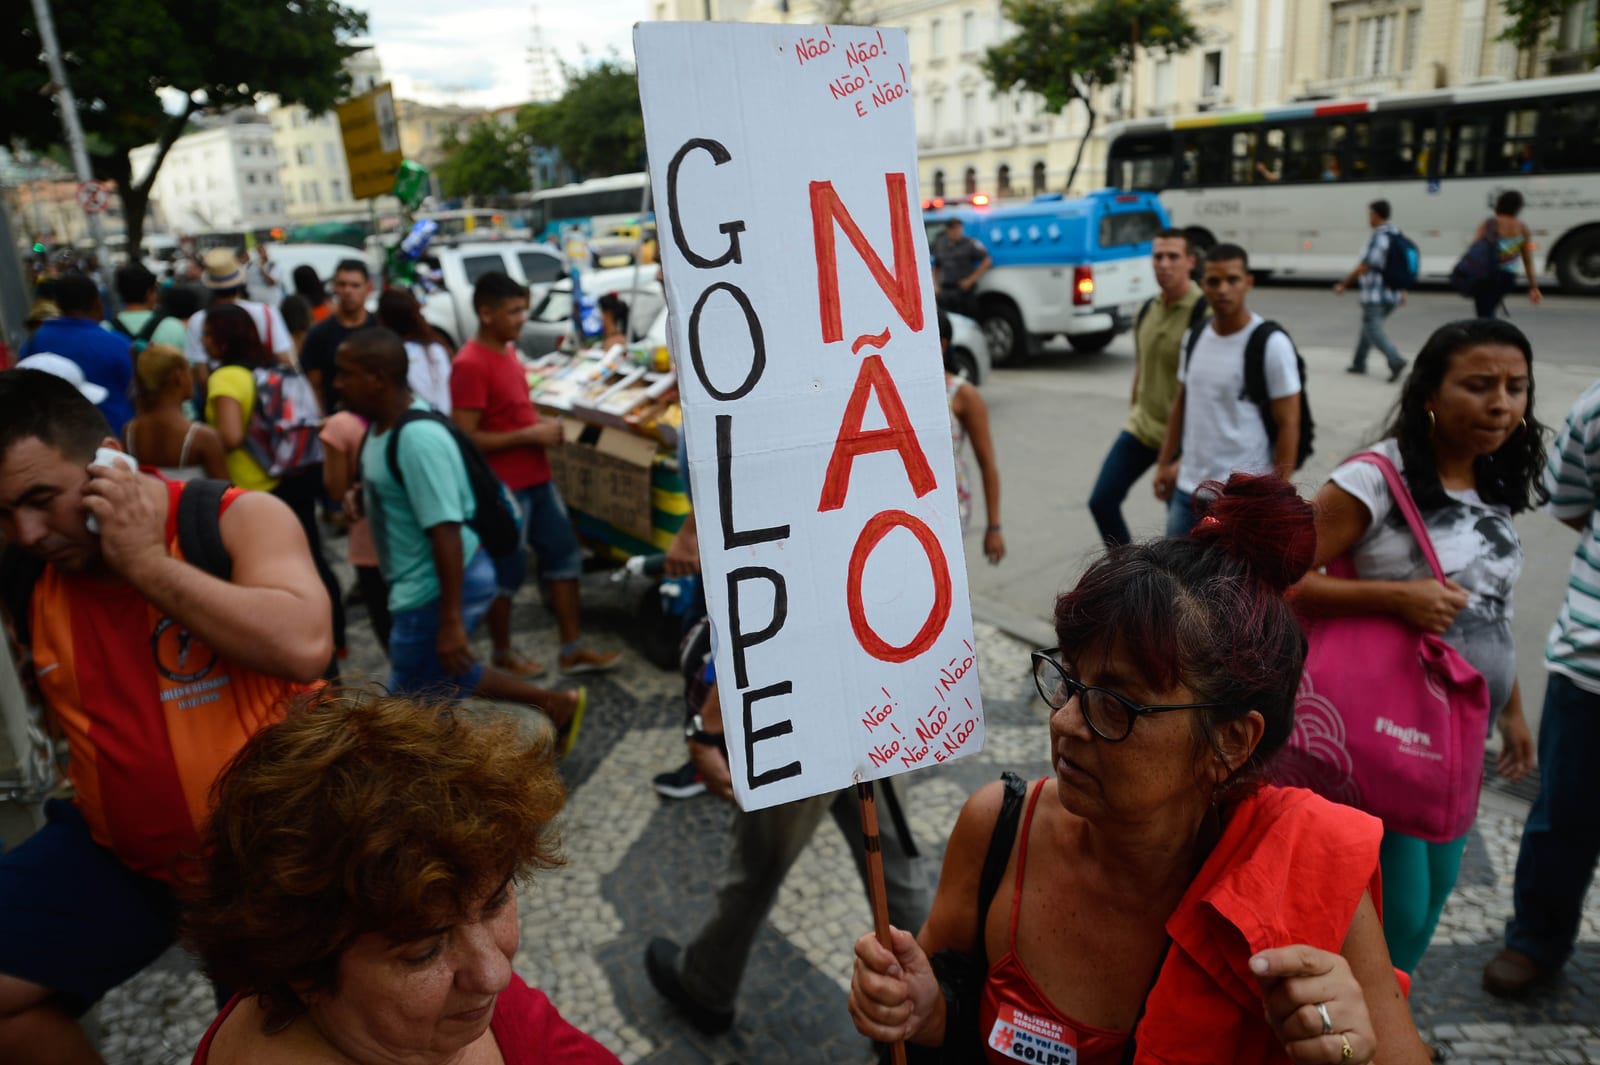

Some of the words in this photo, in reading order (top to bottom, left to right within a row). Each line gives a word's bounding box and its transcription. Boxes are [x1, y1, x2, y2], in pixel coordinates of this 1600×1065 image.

[795, 25, 836, 65] Não!
[846, 30, 887, 69] Não!
[829, 64, 873, 100] Não!
[855, 100, 868, 118] E
[872, 63, 909, 108] Não!
[809, 172, 951, 664] NÃO
[667, 138, 802, 790] GOLPE
[940, 639, 976, 692] Não!
[862, 687, 898, 734] Não!
[915, 685, 951, 745] Não!
[942, 697, 980, 755] Não!
[868, 722, 906, 768] Não!
